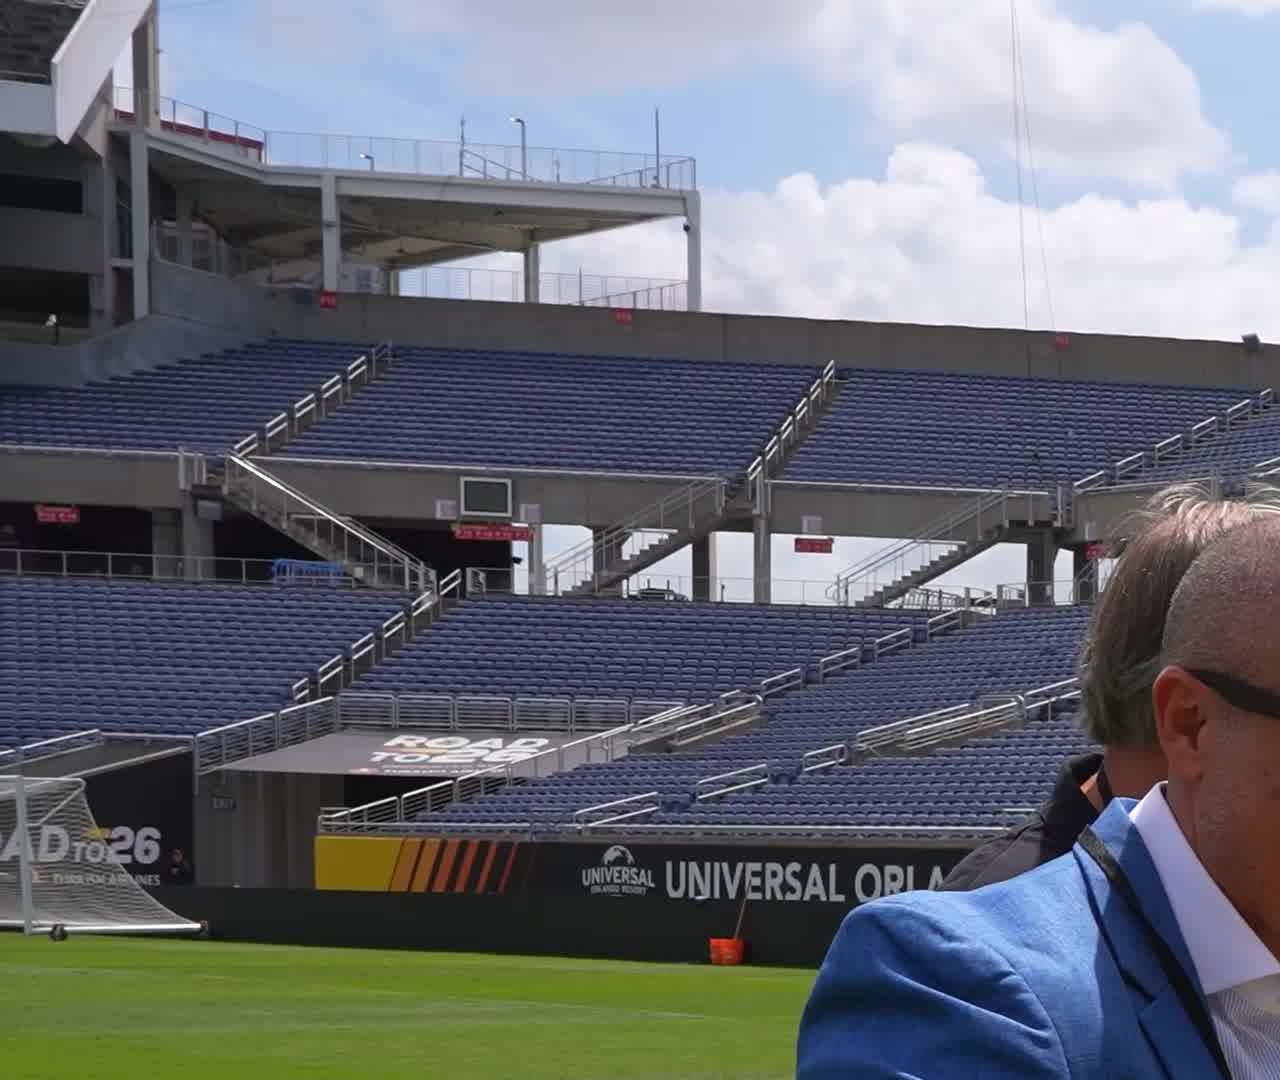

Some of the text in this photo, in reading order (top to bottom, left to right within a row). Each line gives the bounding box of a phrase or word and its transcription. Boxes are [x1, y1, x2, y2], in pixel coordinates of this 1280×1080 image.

[384, 734, 550, 749] ROAD
[0, 826, 70, 862] AD
[111, 825, 161, 864] 26
[582, 866, 656, 888] UNIVERSAL
[664, 860, 846, 902] UNIVERSAL
